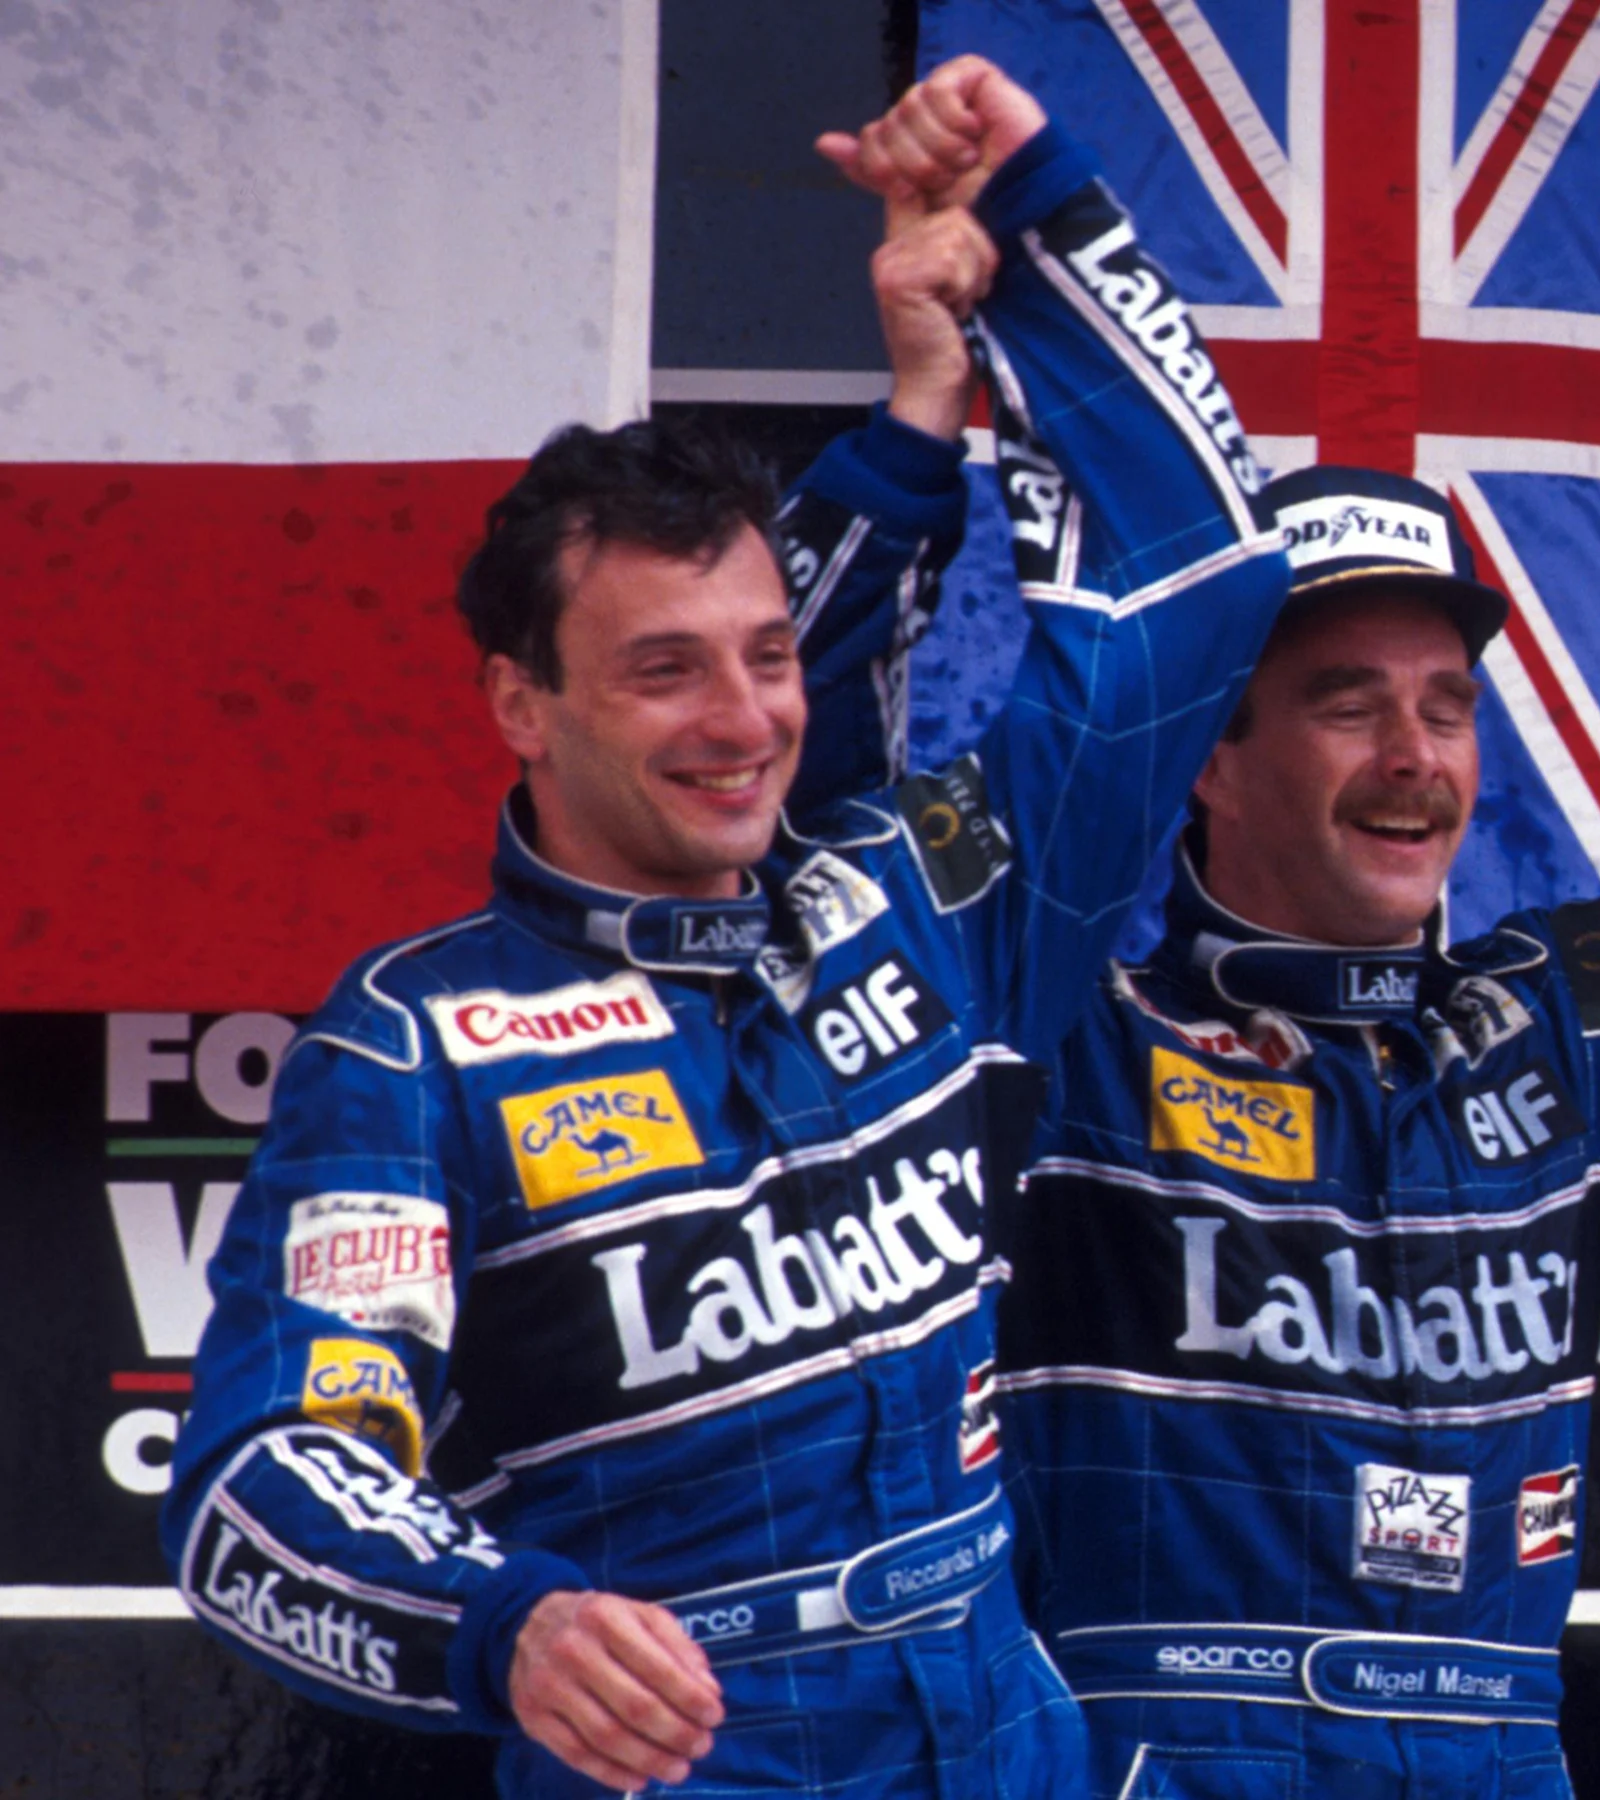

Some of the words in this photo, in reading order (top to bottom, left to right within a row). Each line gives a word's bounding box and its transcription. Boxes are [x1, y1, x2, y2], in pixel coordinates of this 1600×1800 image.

[455, 996, 649, 1048] Canon
[521, 1090, 674, 1155] CAMEL
[1161, 1076, 1301, 1139] CAMEL
[1173, 1217, 1578, 1379] Labatt'
[204, 1524, 397, 1691] Labatt's
[1156, 1645, 1294, 1675] sparco
[1354, 1661, 1427, 1698] Nigel
